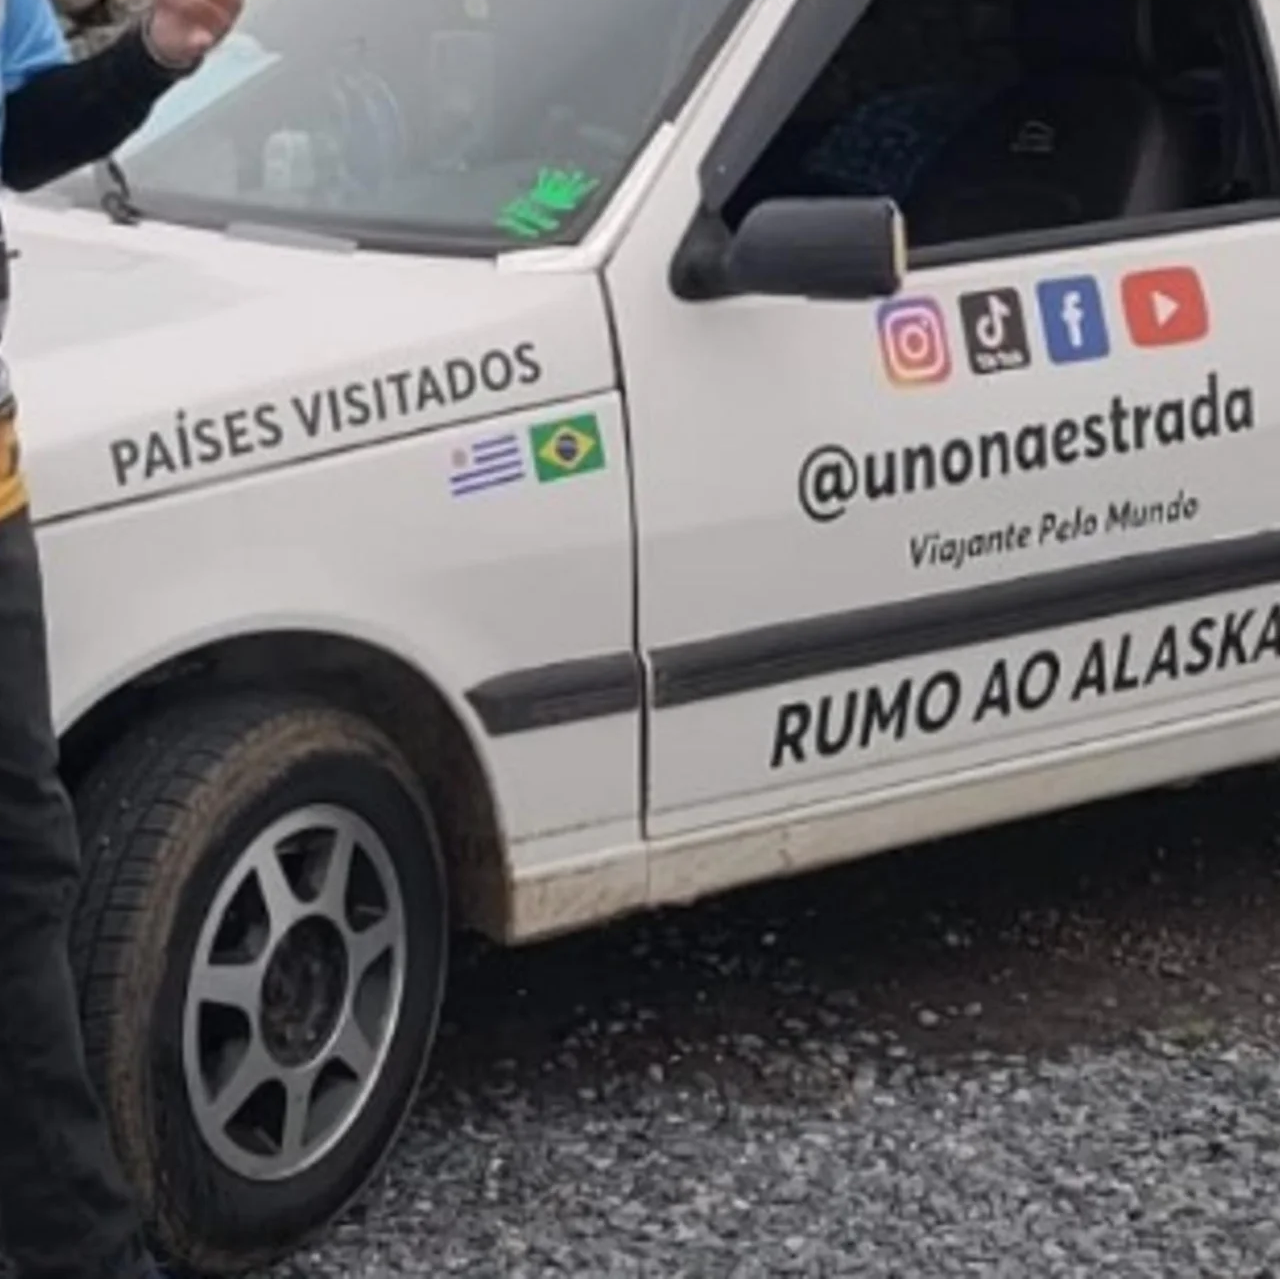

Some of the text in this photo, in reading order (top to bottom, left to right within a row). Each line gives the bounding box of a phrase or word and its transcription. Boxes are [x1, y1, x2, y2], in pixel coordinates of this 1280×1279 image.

[110, 341, 543, 487] PAÍSES VISITADOS
[798, 371, 1255, 522] @unonaestrada
[909, 488, 1200, 569] Viajante Pelo Mundo
[770, 669, 962, 768] RUMO
[972, 648, 1062, 723] AO
